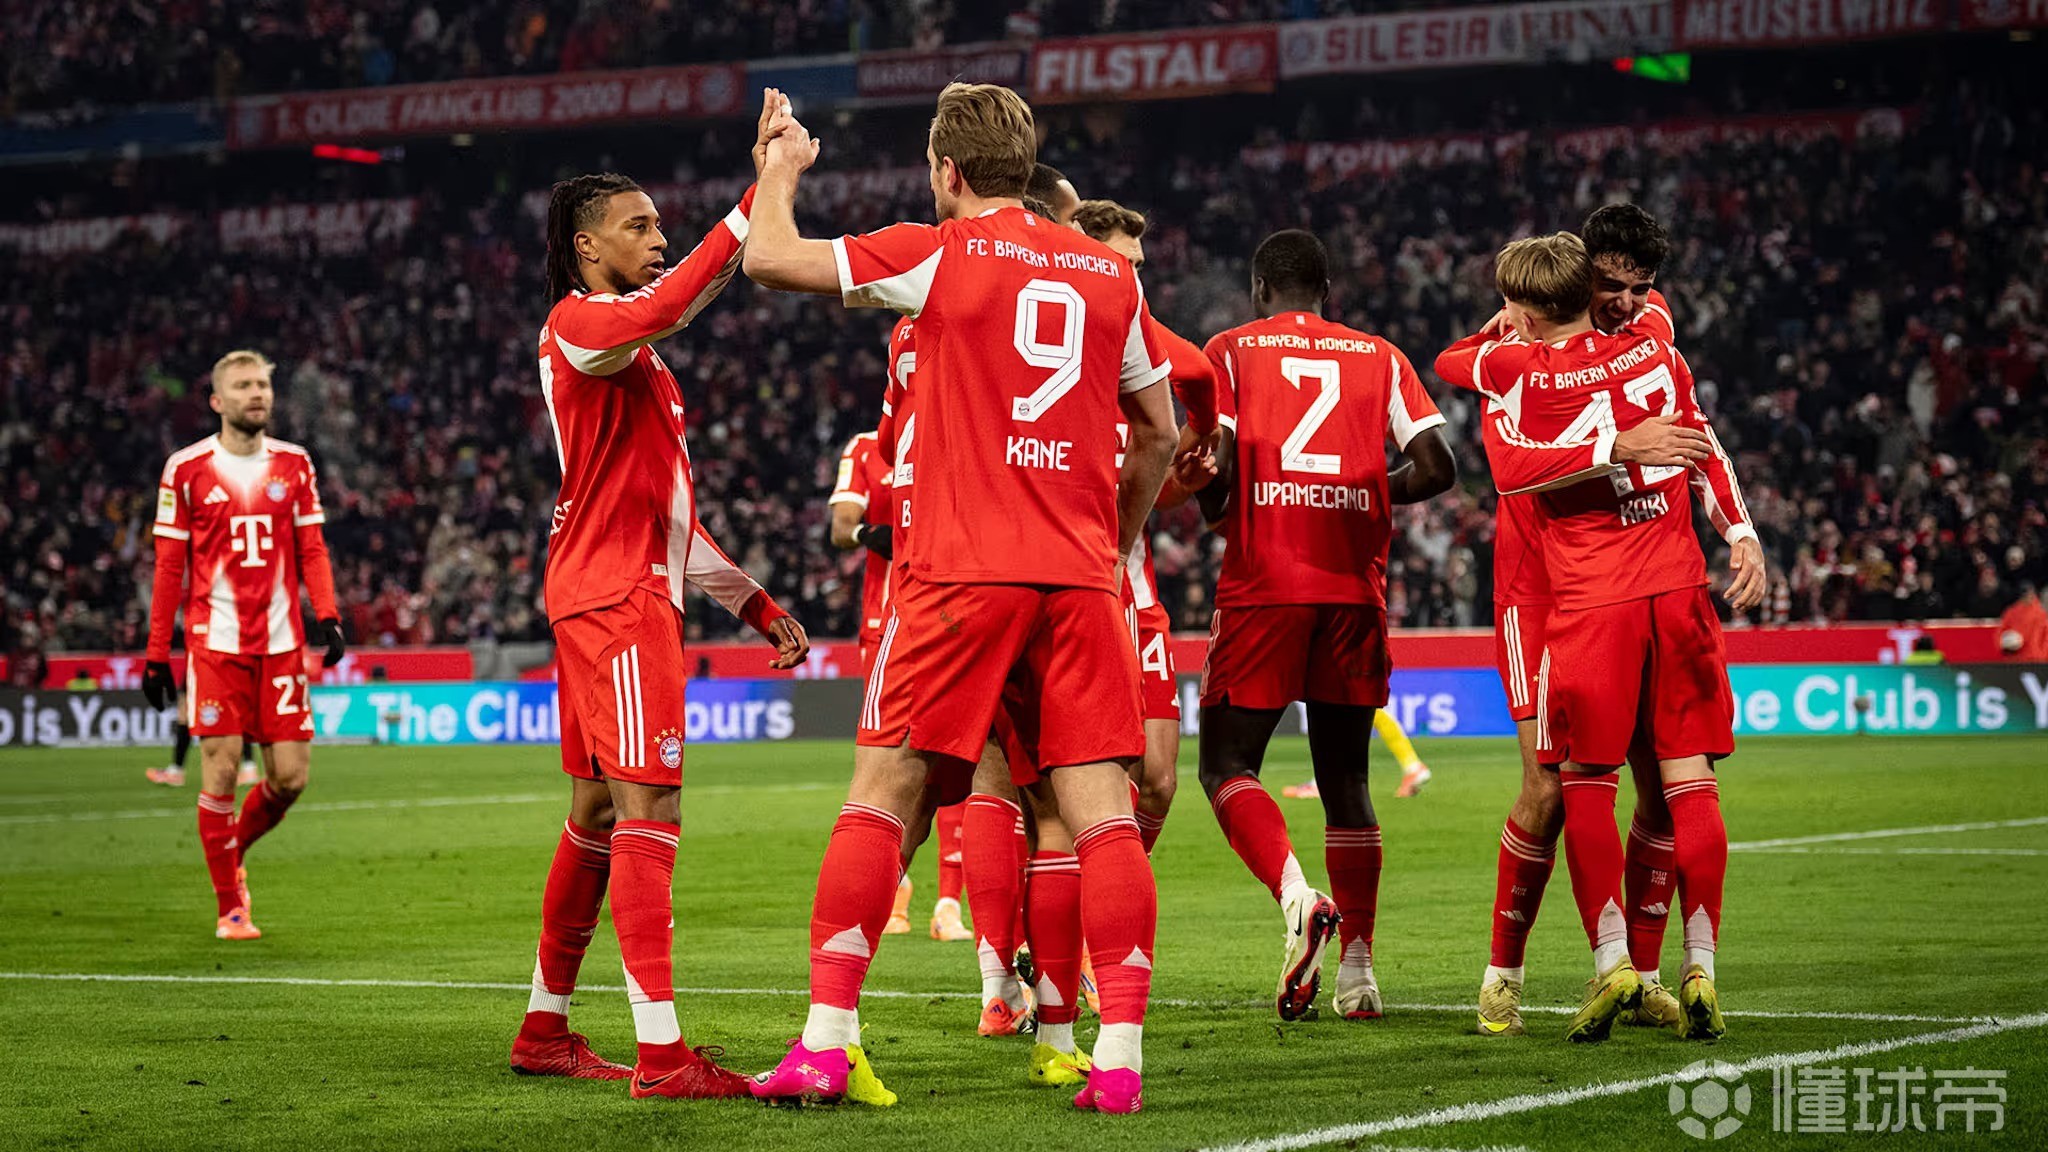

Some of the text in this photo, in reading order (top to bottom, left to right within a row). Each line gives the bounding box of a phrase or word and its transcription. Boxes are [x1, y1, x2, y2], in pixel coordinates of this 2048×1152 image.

[1325, 16, 1492, 64] SILESIA
[1037, 40, 1229, 93] FILSTAL
[966, 237, 1121, 279] FC BAYERN MÜNCHEN
[898, 325, 914, 342] FC
[1011, 277, 1087, 424] 9
[1237, 335, 1256, 349] FC
[1257, 334, 1311, 351] BAYERN
[1529, 371, 1550, 390] FC
[1554, 363, 1610, 391] BAYERN
[1280, 355, 1342, 475] 2
[1005, 435, 1073, 472] KANE
[1253, 480, 1371, 513] UPAMECANO
[1141, 632, 1175, 681] 4
[22, 694, 62, 745] is
[367, 692, 458, 743] The
[684, 699, 795, 741] ours
[1793, 674, 1942, 731] Club
[1956, 671, 2008, 731] is
